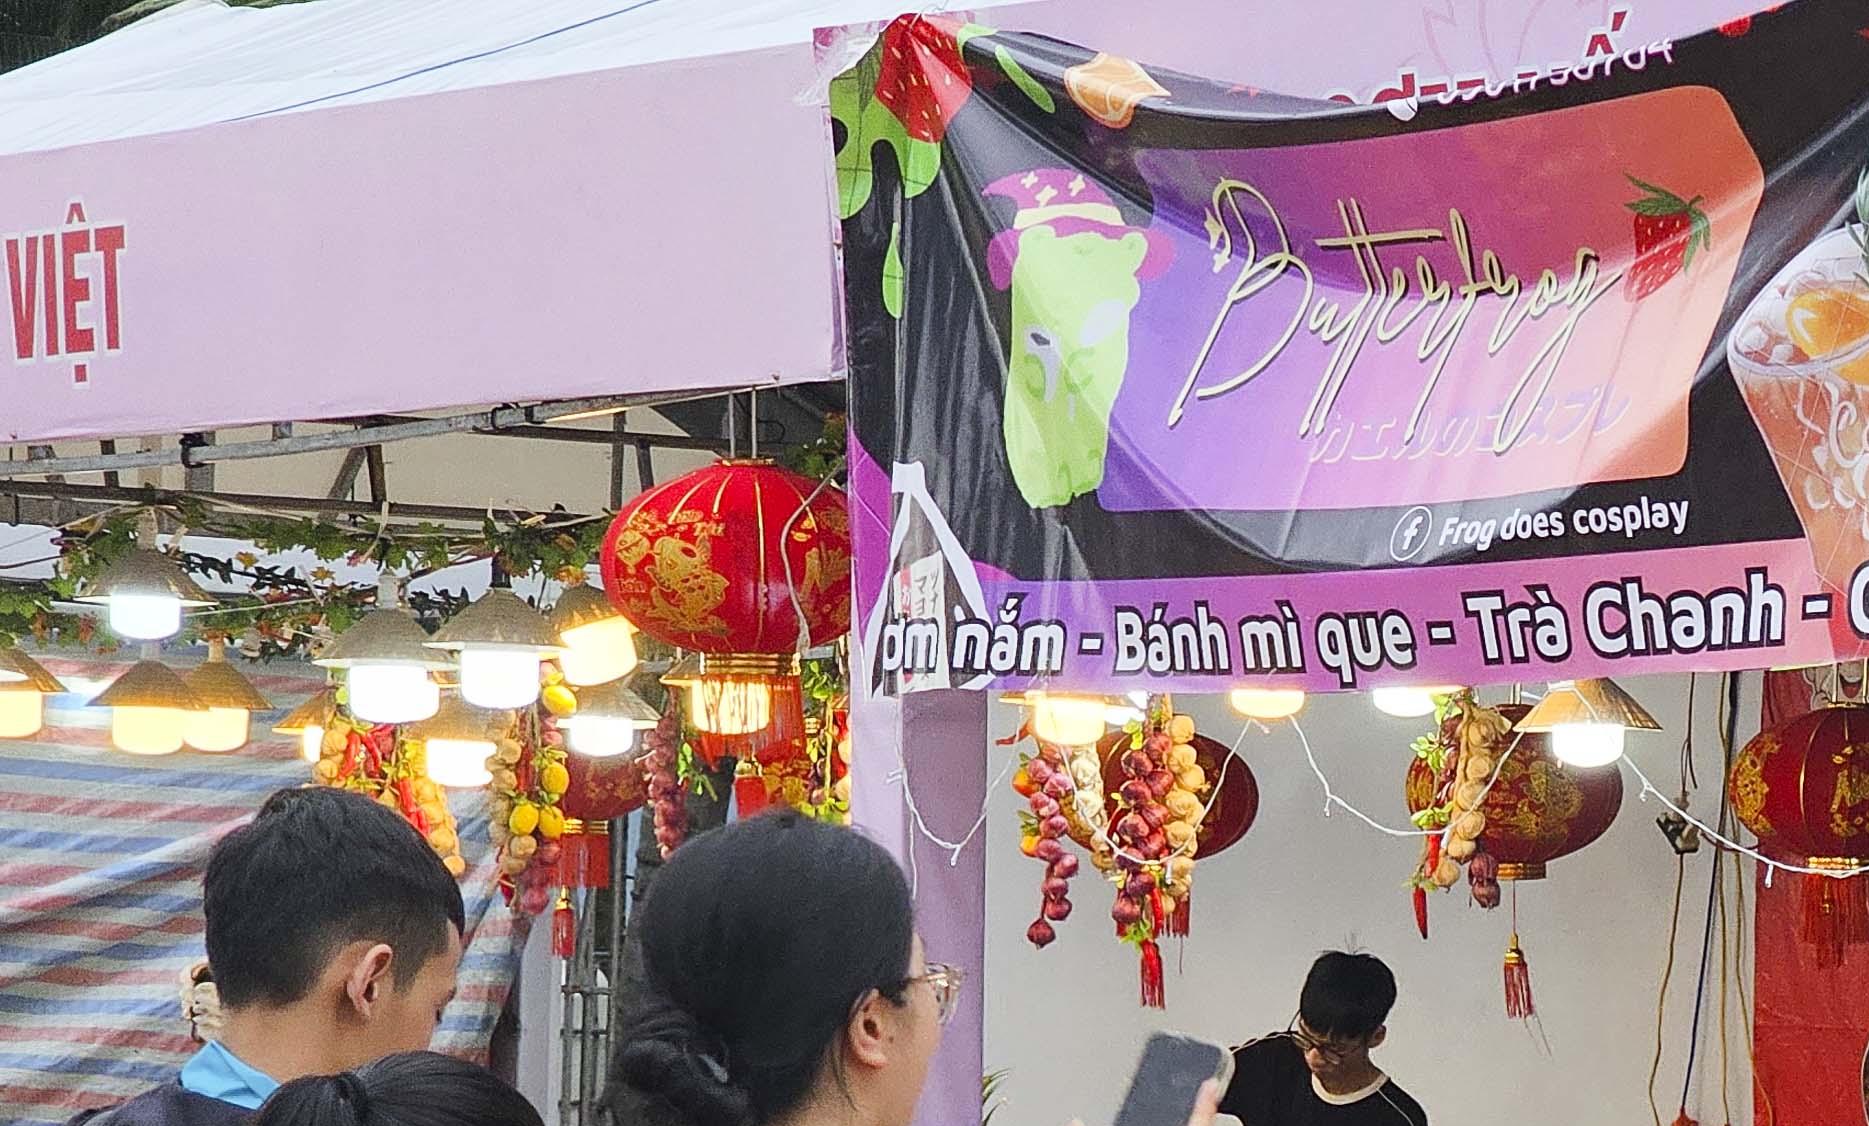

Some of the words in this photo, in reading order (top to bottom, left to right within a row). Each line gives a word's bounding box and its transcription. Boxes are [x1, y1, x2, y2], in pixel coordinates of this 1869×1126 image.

[5, 203, 126, 384] VIỆT
[1438, 516, 1498, 552] Frog
[1500, 506, 1565, 542] does
[1573, 496, 1690, 537] cosplay
[952, 594, 1067, 674] nắm
[1113, 601, 1231, 676] Bánh
[1240, 598, 1305, 674] mì
[1316, 610, 1417, 689] que
[1462, 584, 1573, 665] Trà
[1582, 566, 1787, 658] Chanh
